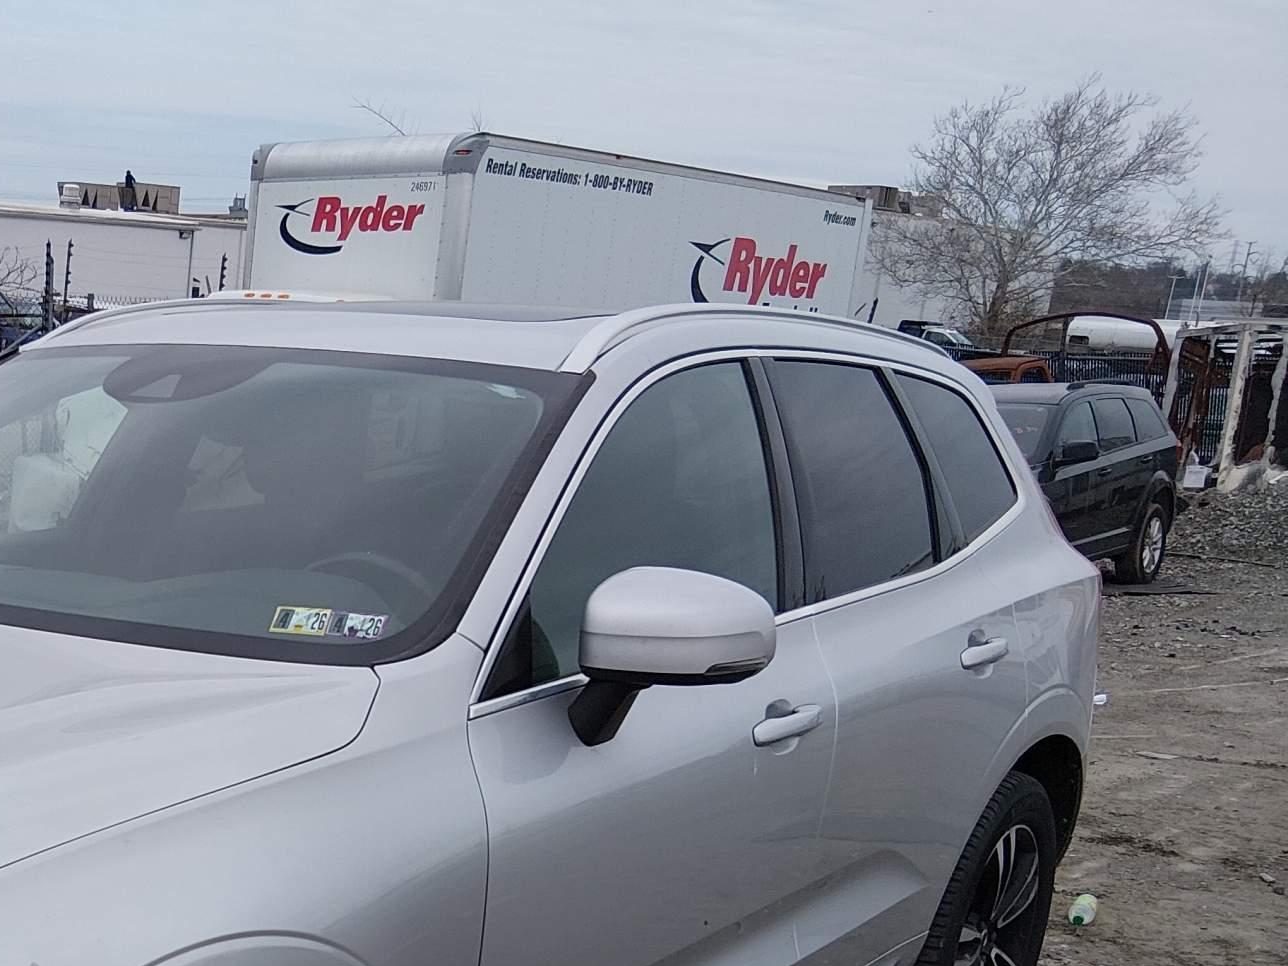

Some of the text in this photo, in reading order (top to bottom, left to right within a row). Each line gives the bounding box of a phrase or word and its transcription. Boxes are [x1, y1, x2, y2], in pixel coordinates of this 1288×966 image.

[485, 158, 654, 196] Rental Reservations: 1-800-BY-RYDER
[310, 194, 426, 241] Ryder
[823, 209, 857, 227] Ryder.com
[722, 237, 828, 303] Ryder
[311, 612, 328, 631] 26
[365, 618, 383, 637] 26
